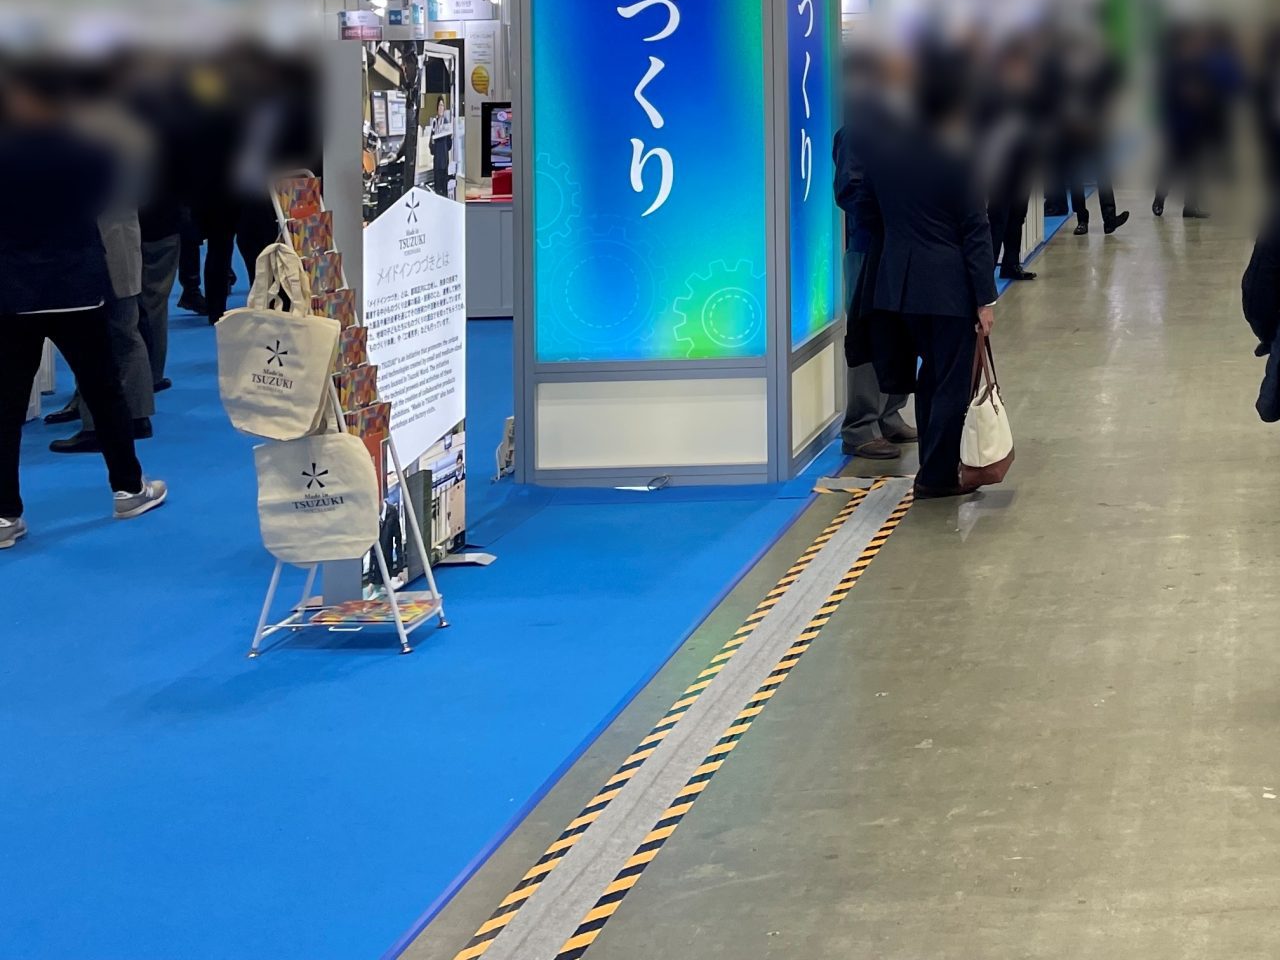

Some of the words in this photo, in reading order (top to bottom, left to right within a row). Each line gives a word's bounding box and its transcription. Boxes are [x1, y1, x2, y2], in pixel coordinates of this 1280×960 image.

[399, 234, 426, 250] TSUZUKI
[252, 373, 293, 389] TSUZUKI
[292, 496, 344, 509] TSUZUKI
